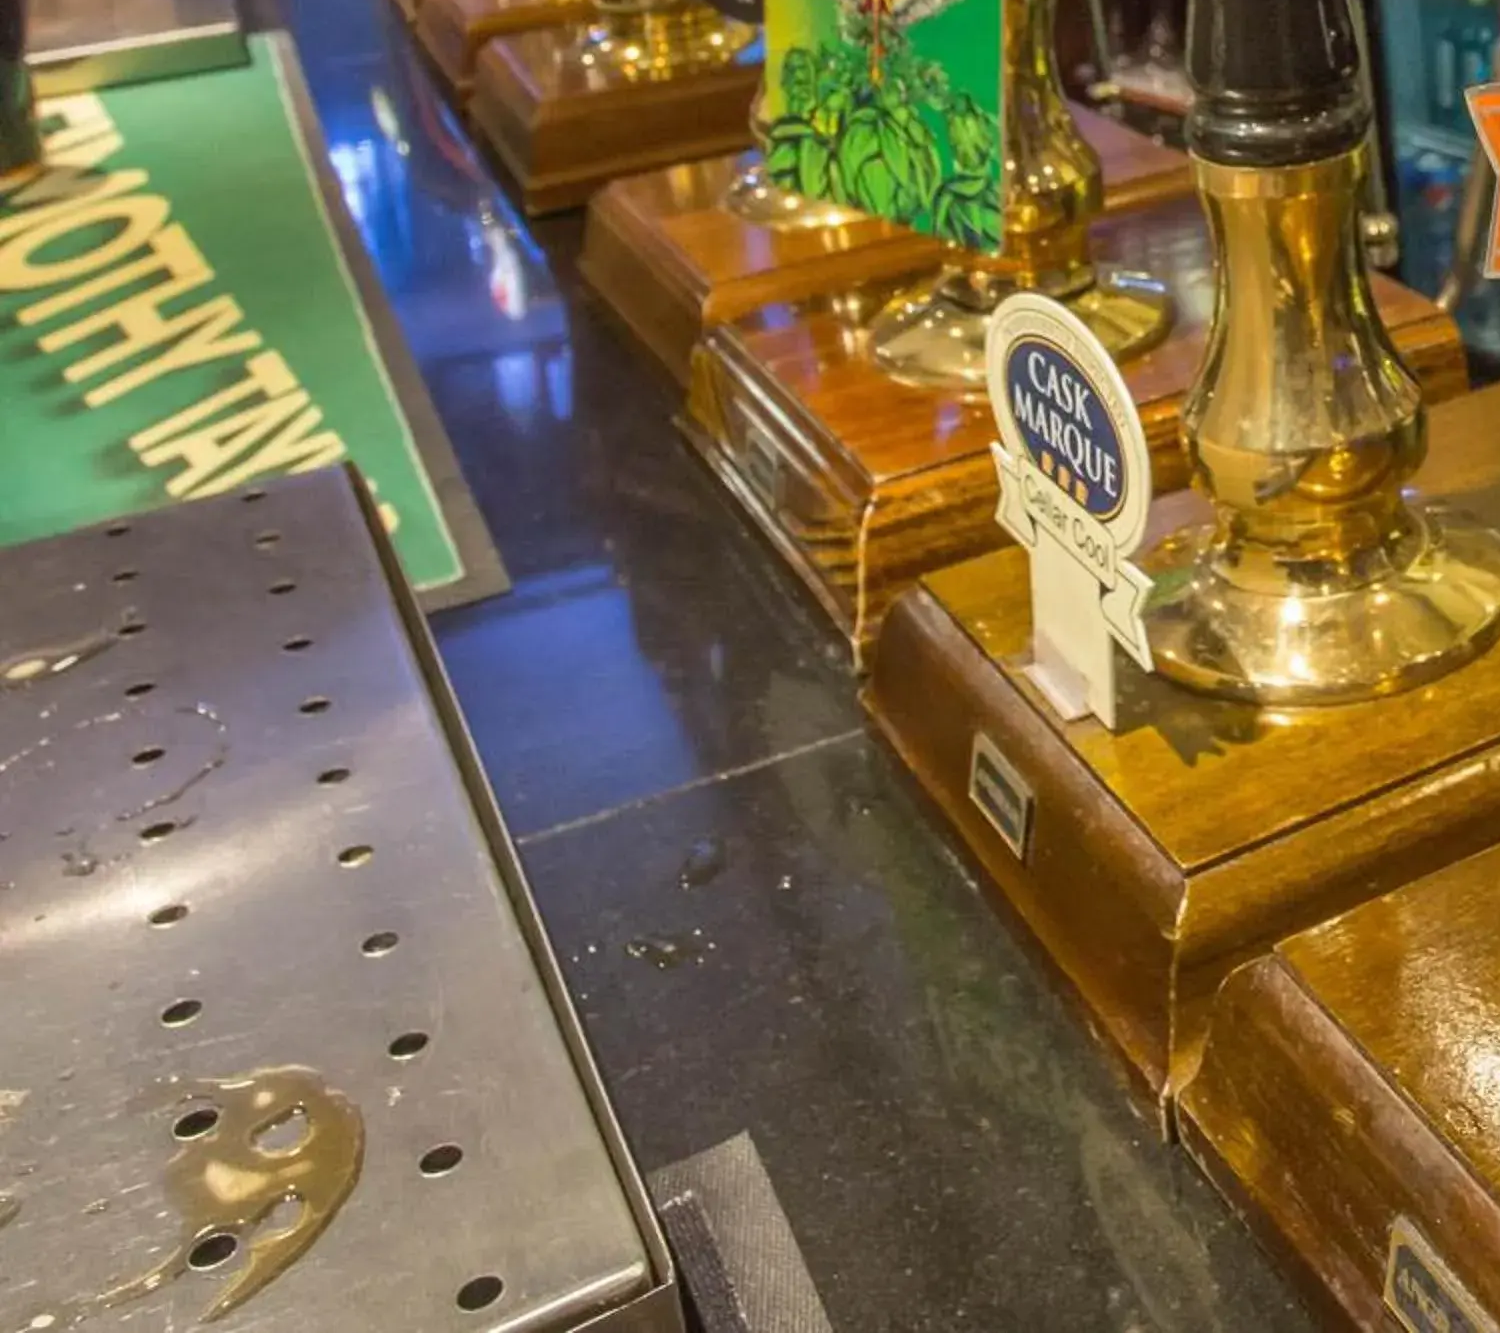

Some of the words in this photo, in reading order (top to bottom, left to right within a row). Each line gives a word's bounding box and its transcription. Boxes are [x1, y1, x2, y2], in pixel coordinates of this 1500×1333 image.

[1027, 350, 1094, 430] CASK
[1013, 382, 1119, 498] MARQUE
[1022, 472, 1069, 534] Cellar
[1072, 517, 1111, 569] Cool
